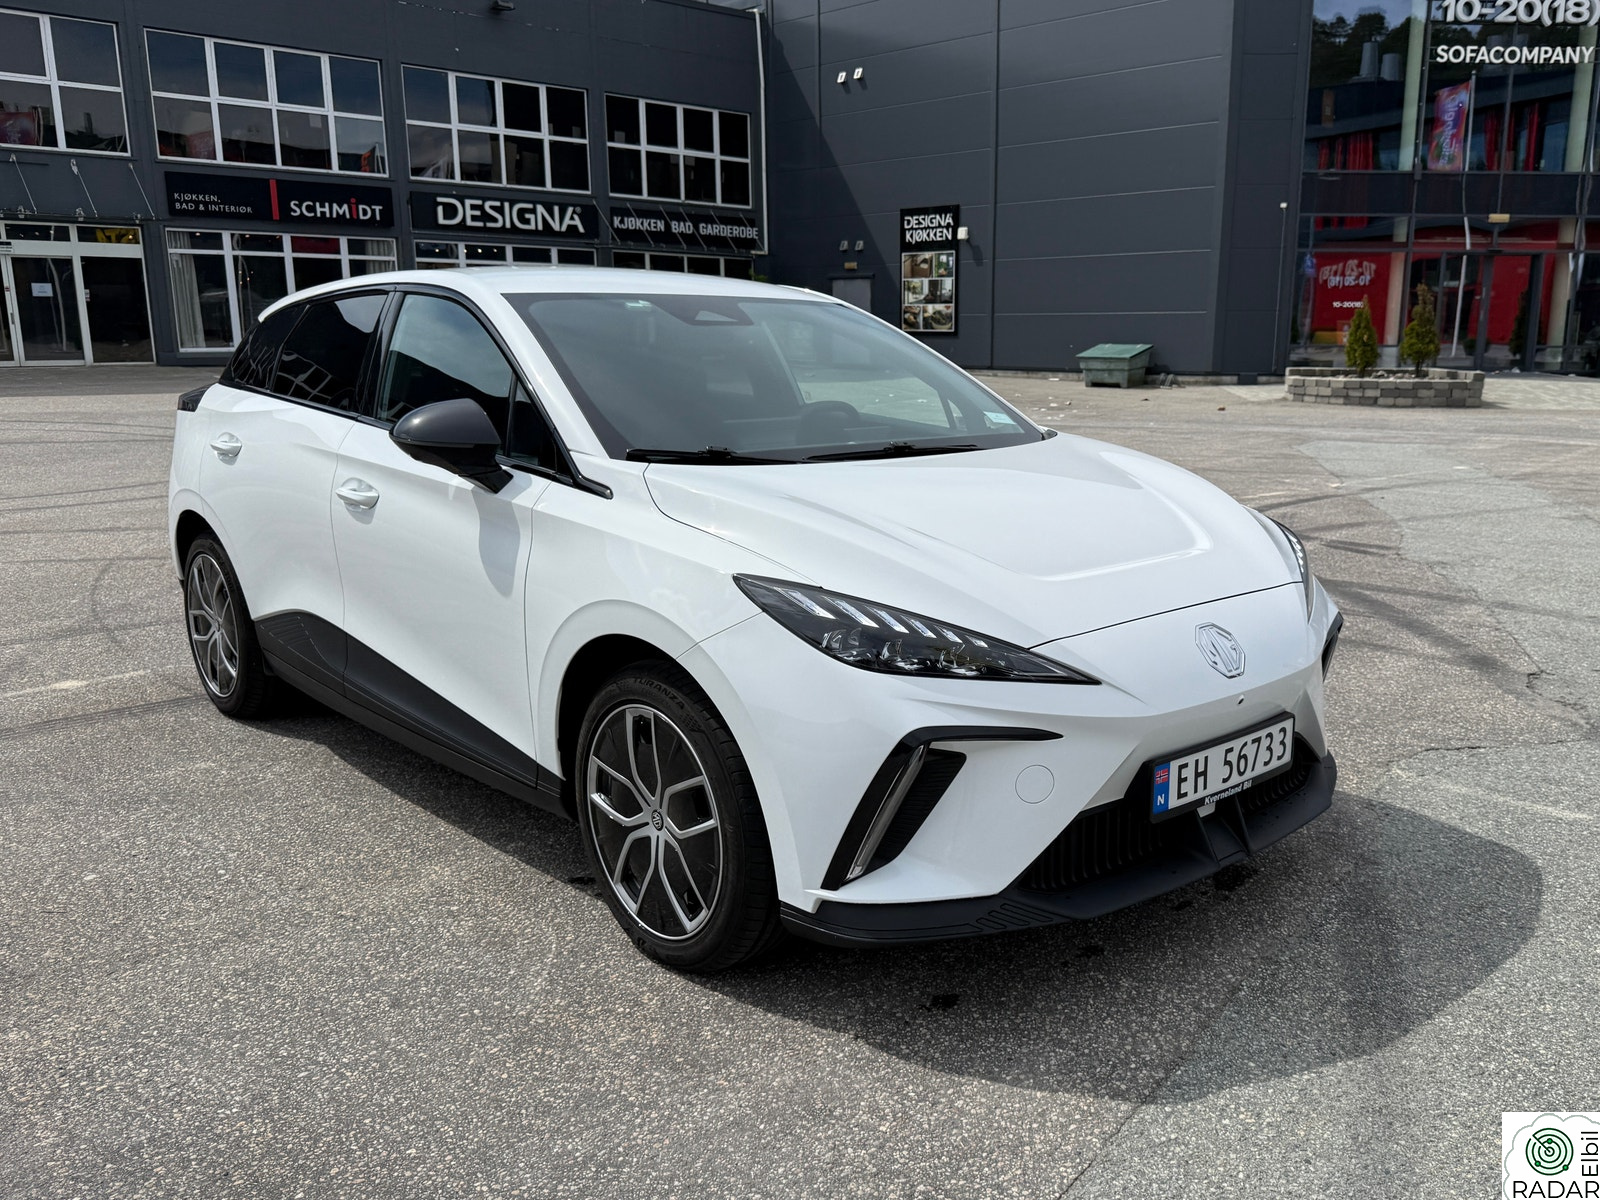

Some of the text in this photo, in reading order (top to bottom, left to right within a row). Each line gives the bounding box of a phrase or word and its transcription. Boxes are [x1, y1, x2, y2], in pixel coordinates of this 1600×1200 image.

[1441, 0, 1599, 27] 10-20(18)
[1436, 45, 1594, 64] SOFACOMPANY
[208, 205, 253, 214] INTERIØR
[613, 216, 759, 239] KJØKKEN BAD GARDEROBE
[906, 228, 952, 245] KJØKKEN
[1177, 726, 1287, 801] EH 56733
[1157, 794, 1165, 806] N
